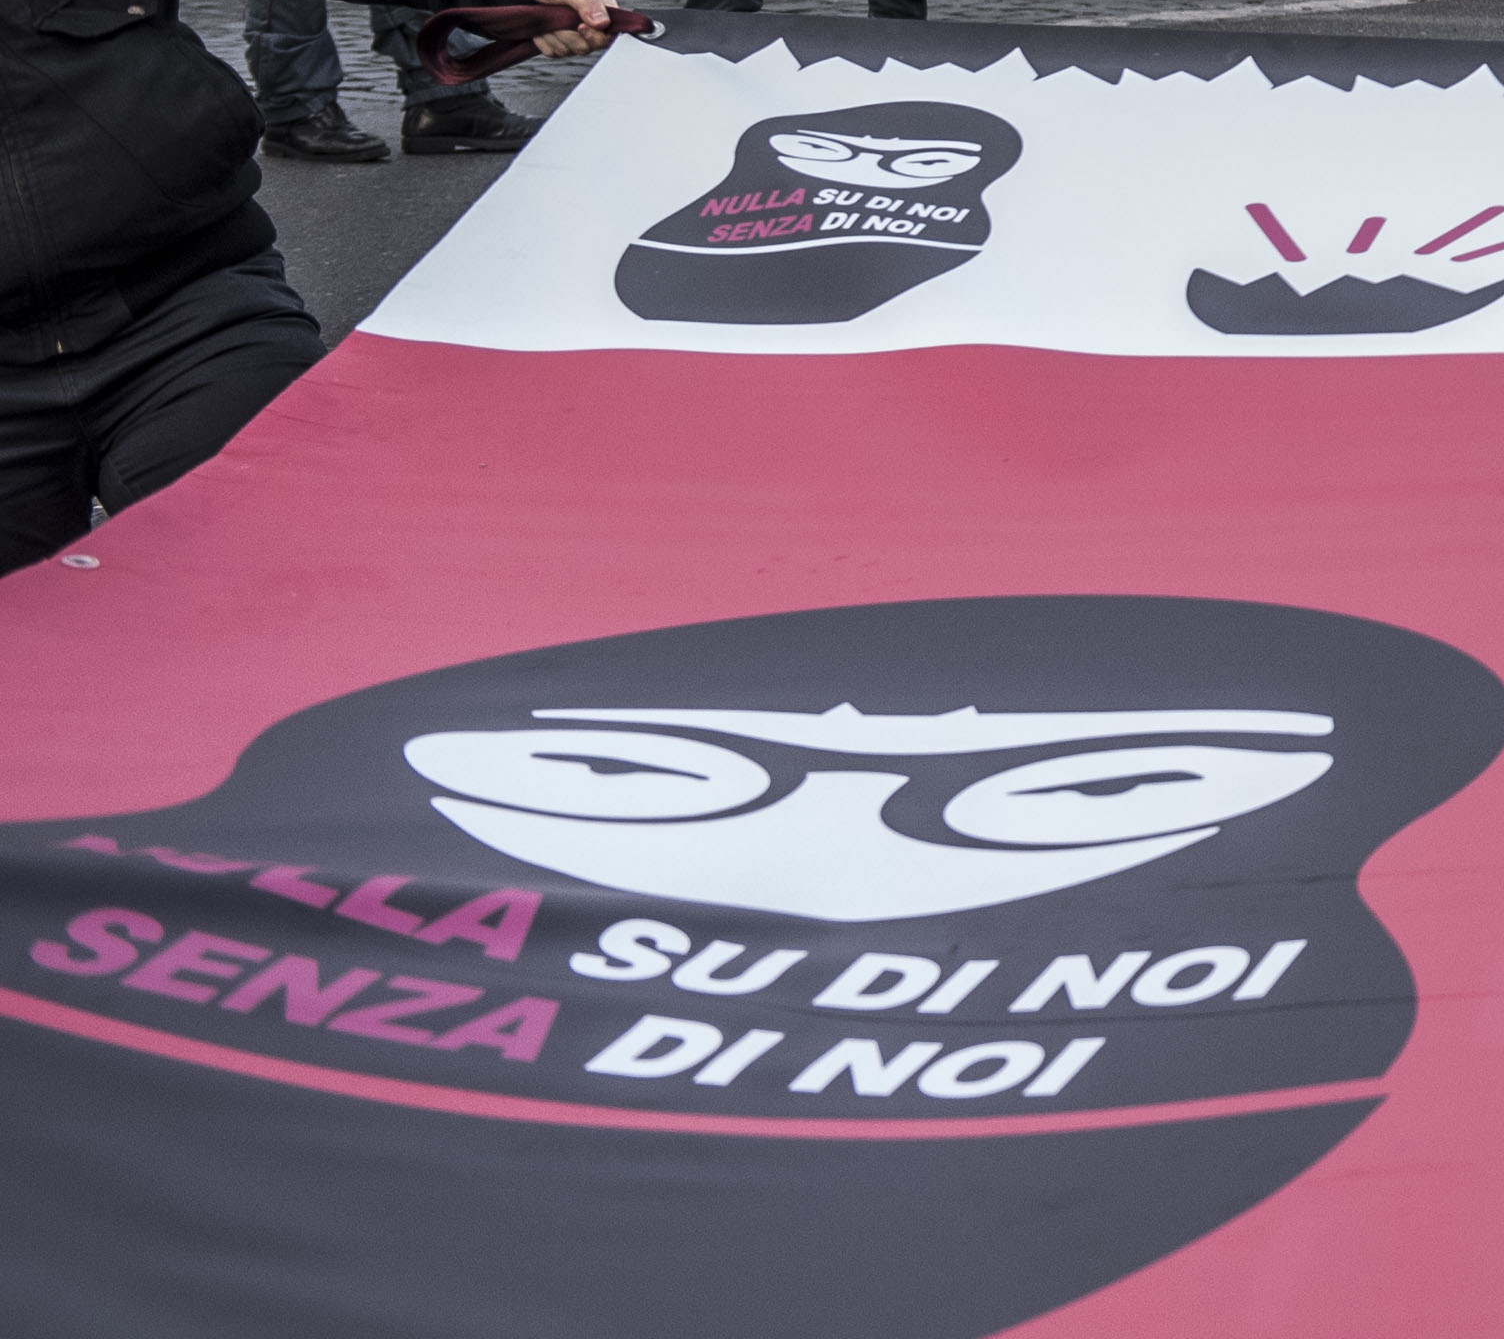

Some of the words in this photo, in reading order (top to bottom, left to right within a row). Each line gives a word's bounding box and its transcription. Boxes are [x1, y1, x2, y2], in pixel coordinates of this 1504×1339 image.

[700, 188, 806, 217] NULLA
[812, 188, 864, 206] SU
[865, 195, 905, 212] DI
[906, 202, 970, 223] NOI
[707, 212, 813, 243] SENZA
[819, 211, 861, 231] DI
[861, 215, 927, 236] NOI
[569, 918, 809, 995] SU
[812, 952, 1000, 1014] DI
[1009, 939, 1307, 1013] NOI
[30, 906, 561, 1062] SENZA
[585, 1014, 785, 1086] DI
[788, 1036, 1106, 1099] NOI
